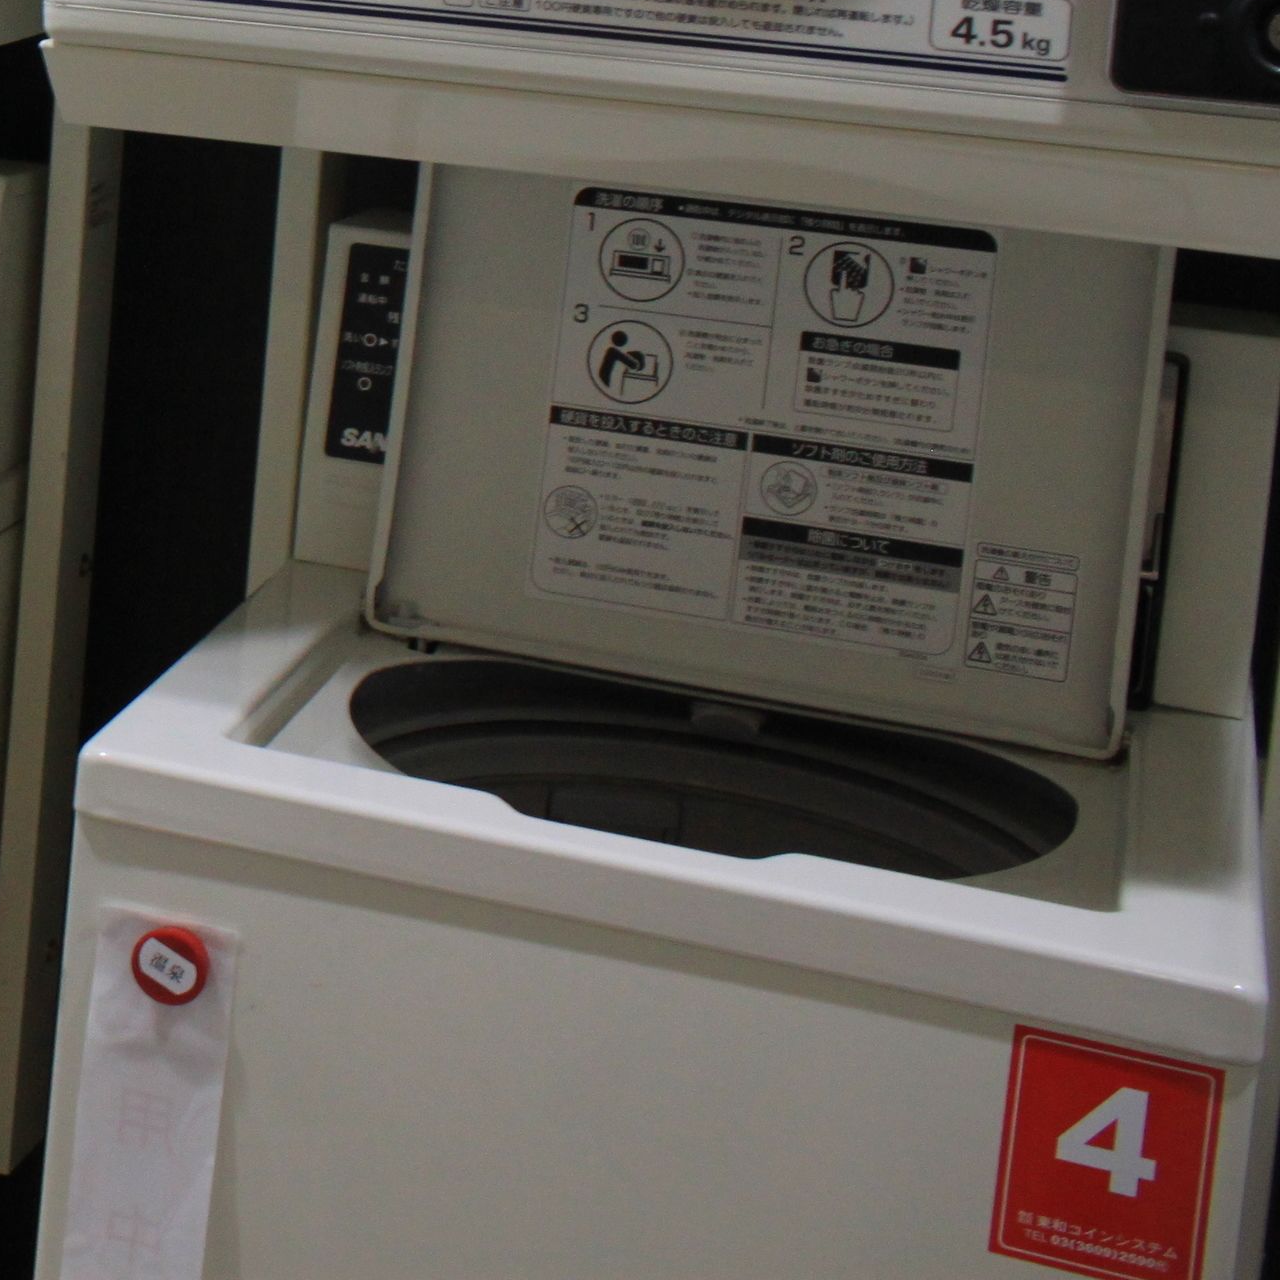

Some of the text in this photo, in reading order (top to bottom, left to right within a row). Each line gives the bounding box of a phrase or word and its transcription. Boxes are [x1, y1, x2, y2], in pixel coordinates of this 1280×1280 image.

[951, 16, 1051, 56] 4.5 kg
[588, 212, 595, 232] 1
[788, 235, 806, 256] 2
[573, 303, 590, 323] 3
[149, 951, 187, 984] 温泉
[1055, 1086, 1157, 1199] 4
[1023, 1228, 1047, 1243] TEL
